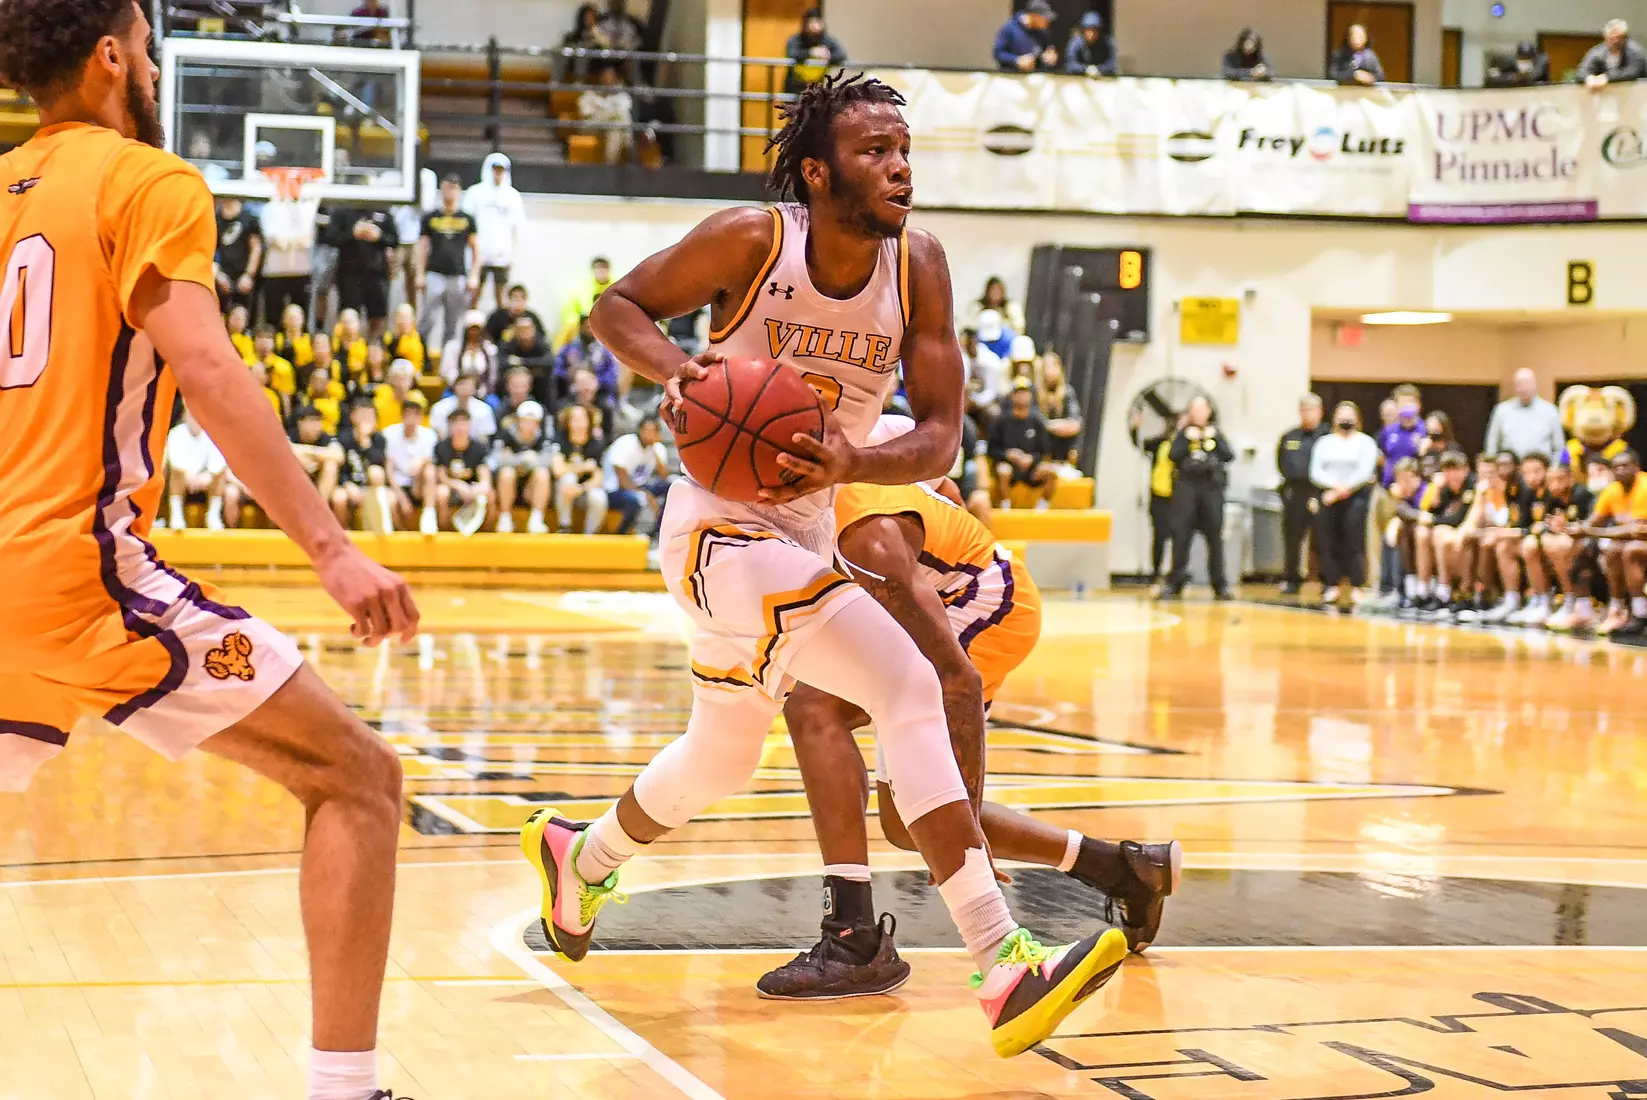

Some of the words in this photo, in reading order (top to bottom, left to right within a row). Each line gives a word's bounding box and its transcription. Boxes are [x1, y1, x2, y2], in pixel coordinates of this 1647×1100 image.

[1237, 127, 1305, 158] Frey
[1436, 104, 1561, 143] UPMC
[1434, 145, 1578, 182] Pinnacle
[1567, 260, 1593, 305] B
[764, 317, 893, 375] VILLE
